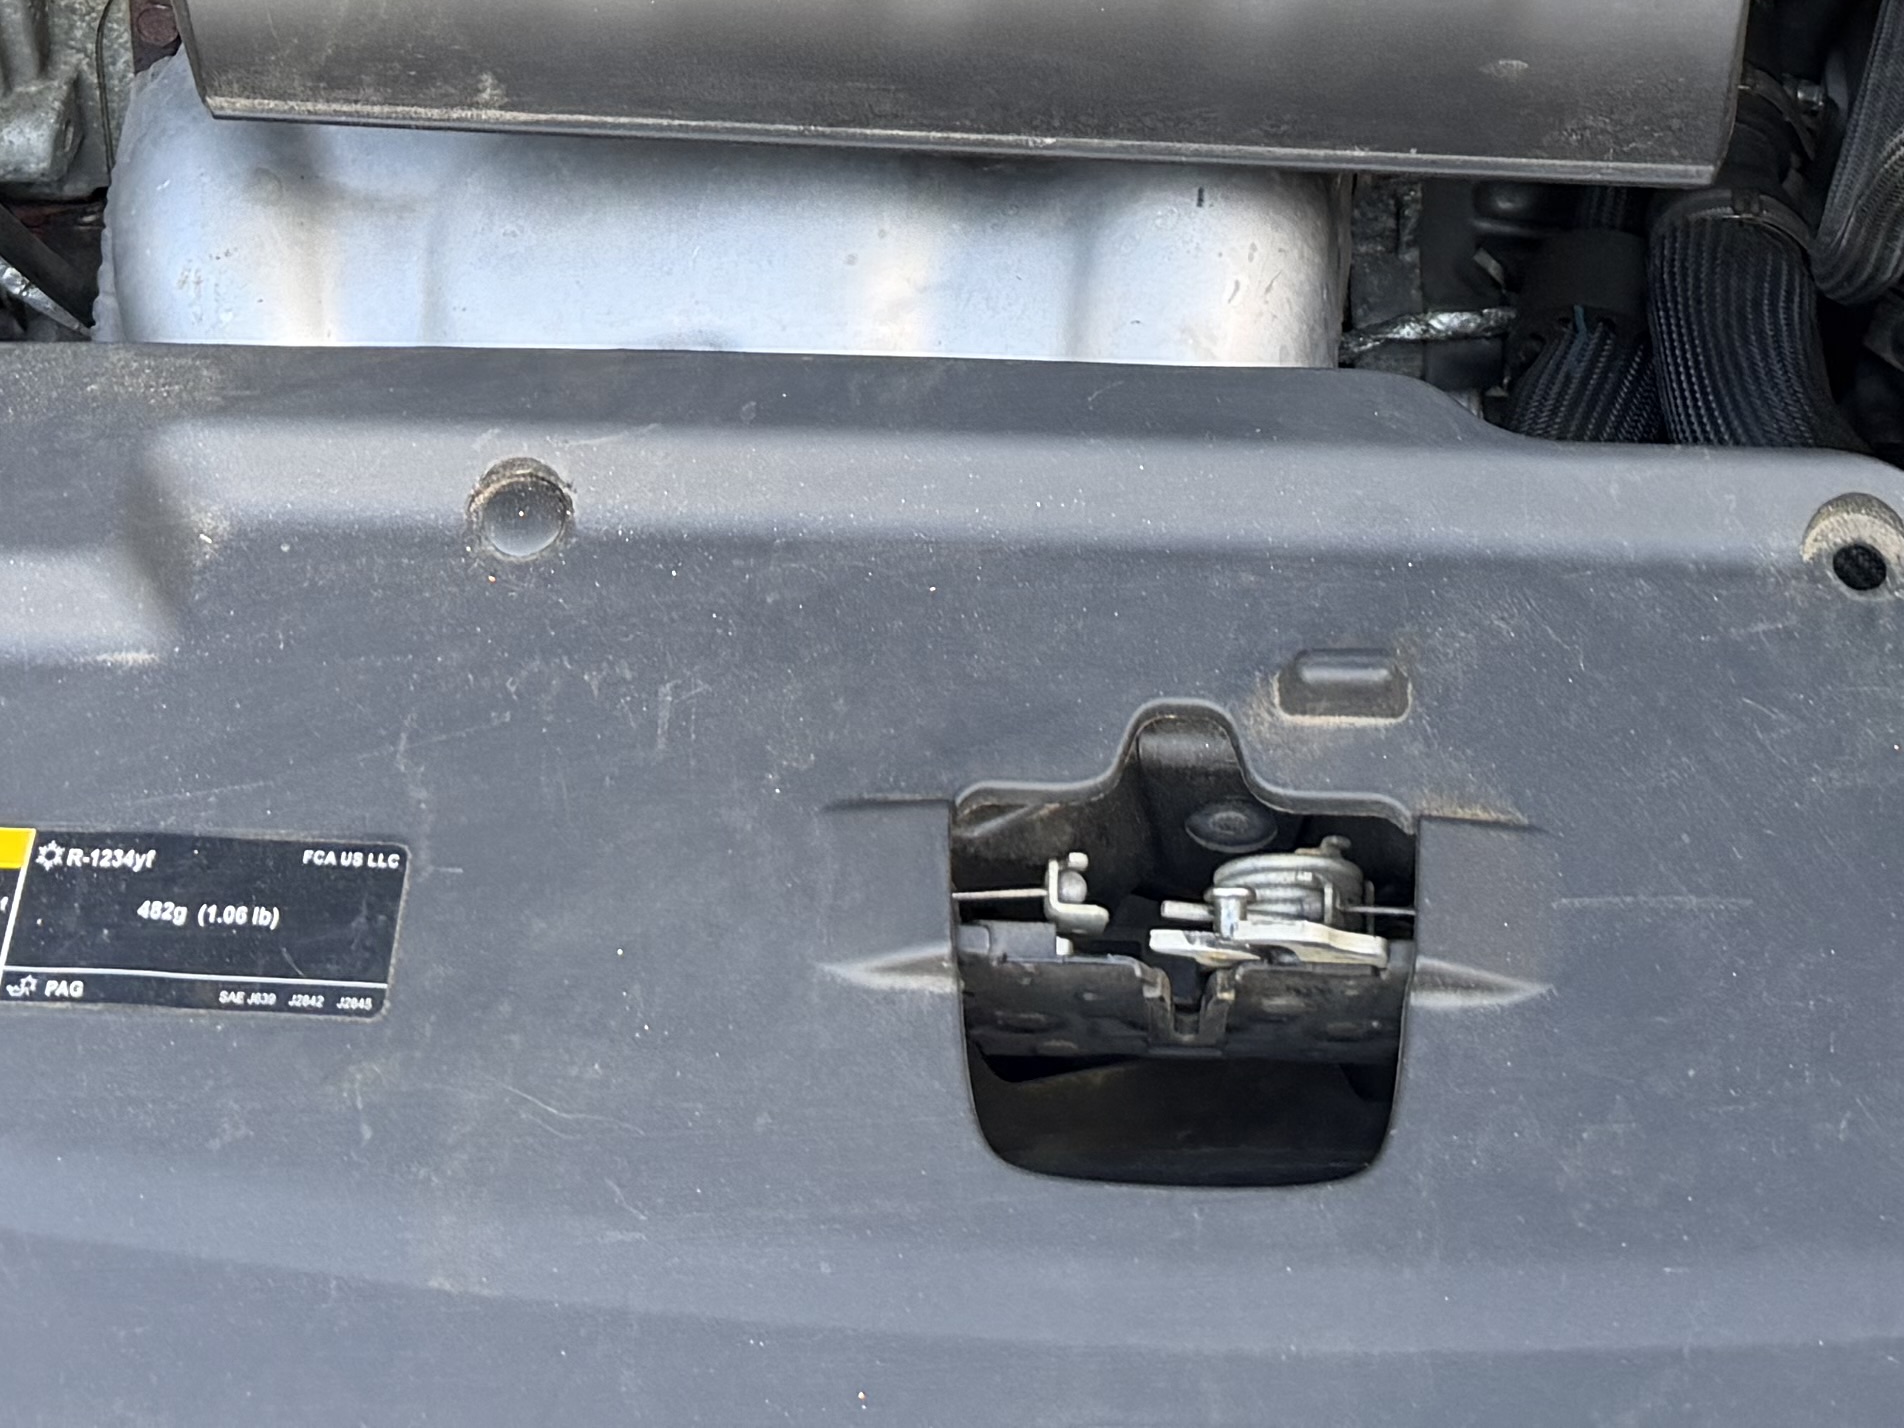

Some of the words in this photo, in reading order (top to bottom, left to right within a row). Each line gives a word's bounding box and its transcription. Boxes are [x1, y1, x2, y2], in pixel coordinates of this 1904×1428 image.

[66, 847, 157, 873] R-1234yf
[302, 849, 337, 866] FCA
[340, 850, 364, 867] US
[367, 850, 401, 869] LLC
[136, 899, 188, 926] 482g
[197, 903, 248, 928] (1.06
[252, 905, 280, 931] lb)
[43, 979, 84, 998] PAG
[218, 990, 245, 1005] SAE
